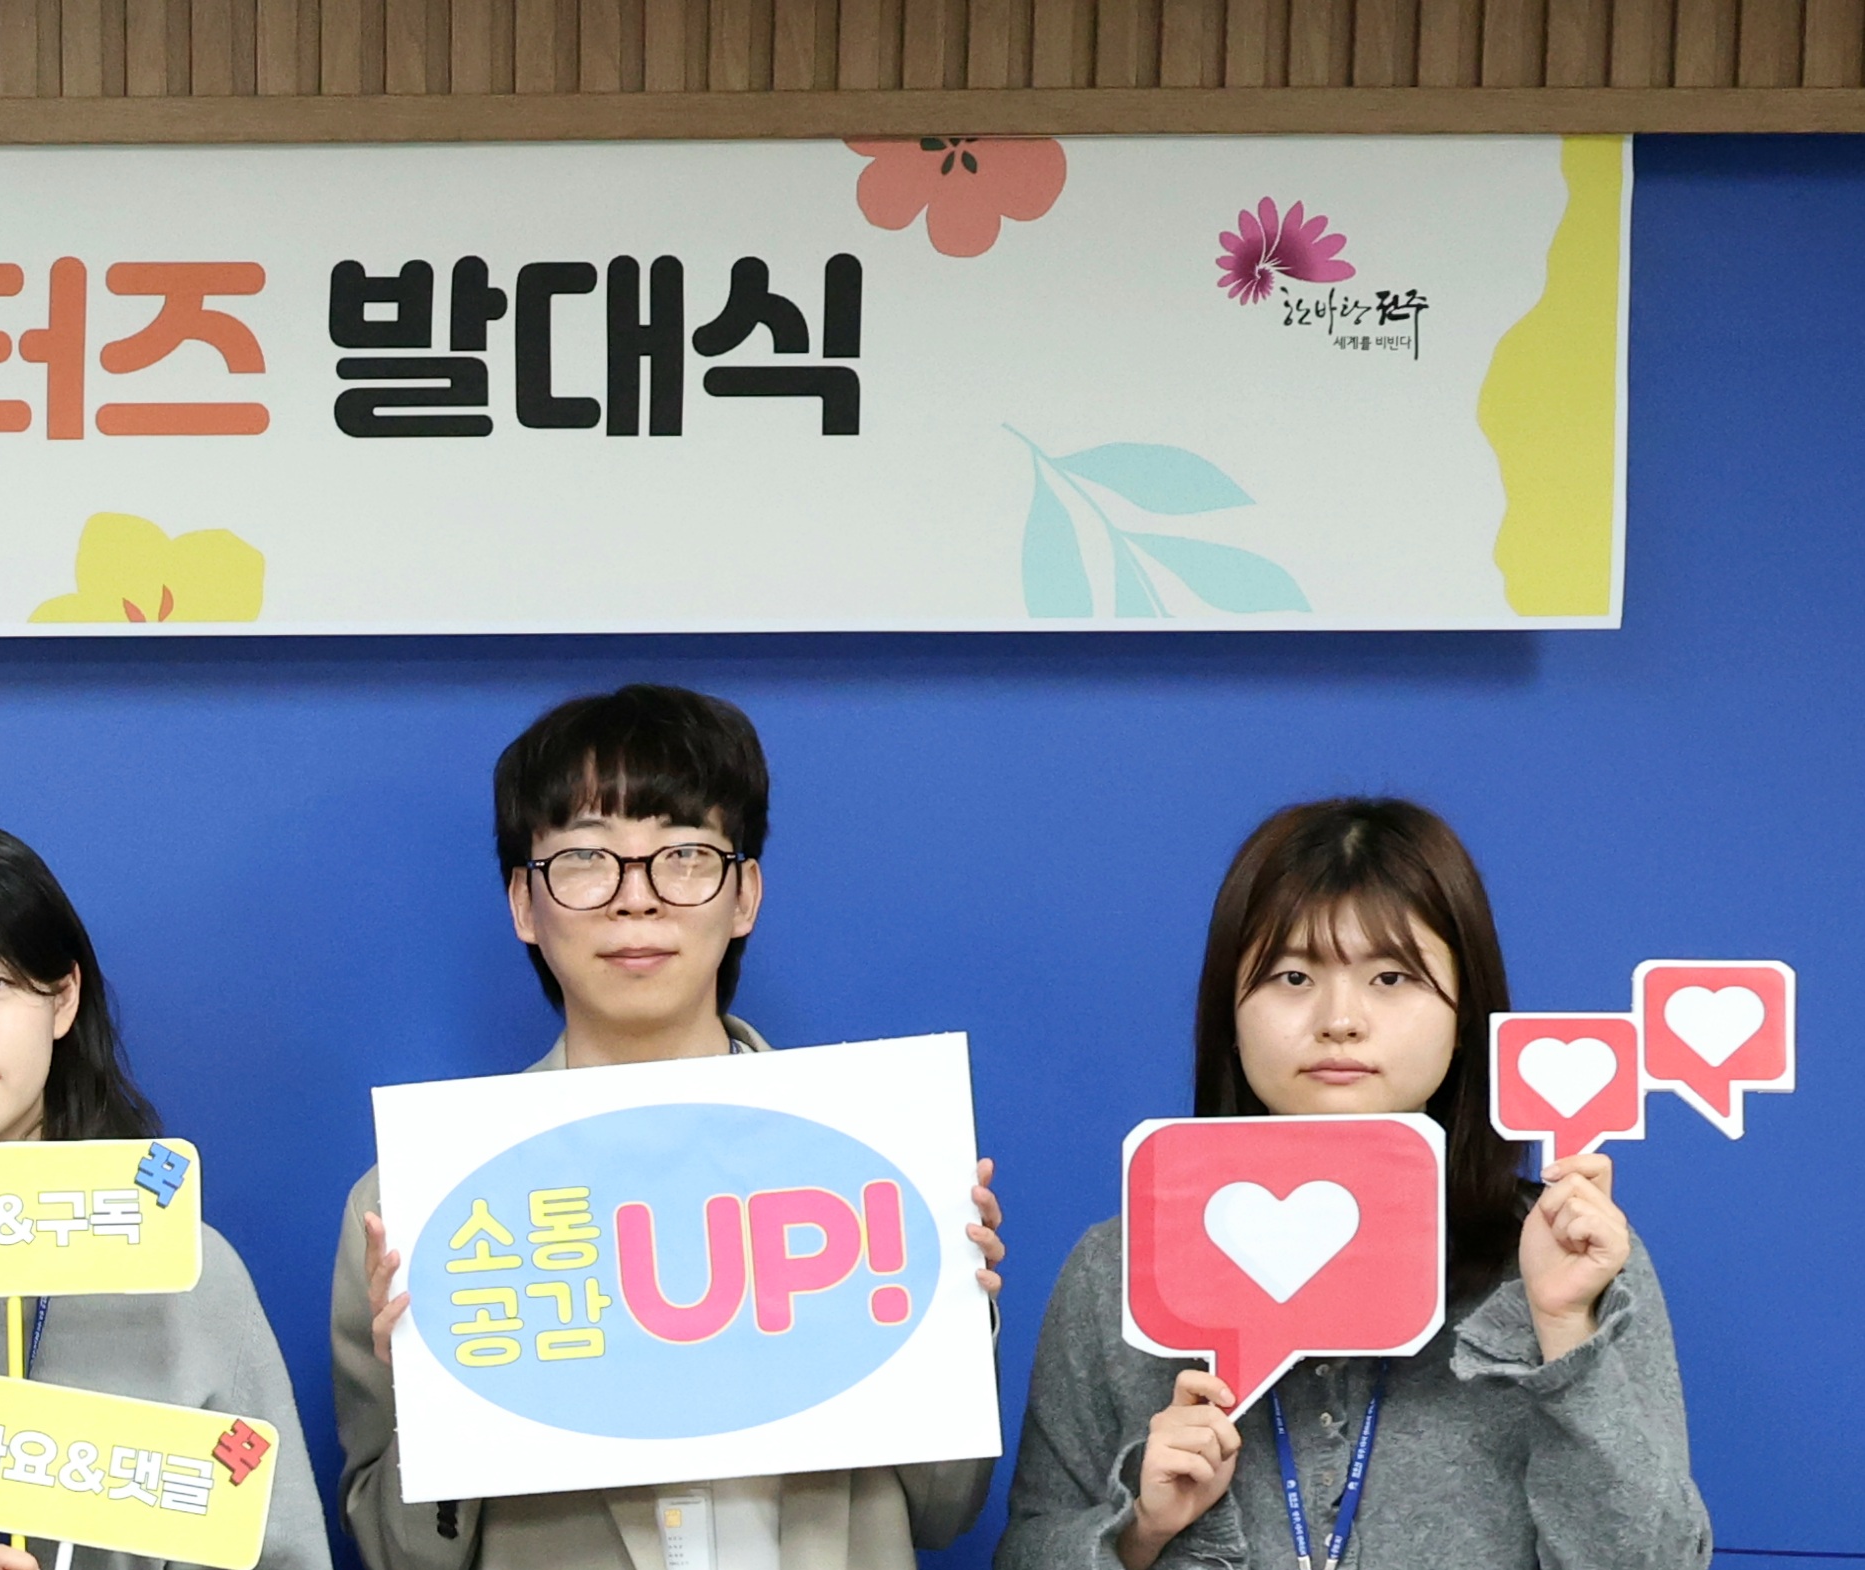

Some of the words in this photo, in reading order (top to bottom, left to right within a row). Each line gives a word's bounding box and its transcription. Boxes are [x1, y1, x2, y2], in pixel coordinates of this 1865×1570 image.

[327, 252, 863, 438] 발대식
[1332, 335, 1372, 351] 세계를
[1374, 334, 1413, 351] 비빈다
[1374, 287, 1430, 362] 전주
[445, 1185, 602, 1274] 소통
[614, 1178, 913, 1345] UP!
[449, 1276, 613, 1368] 공감
